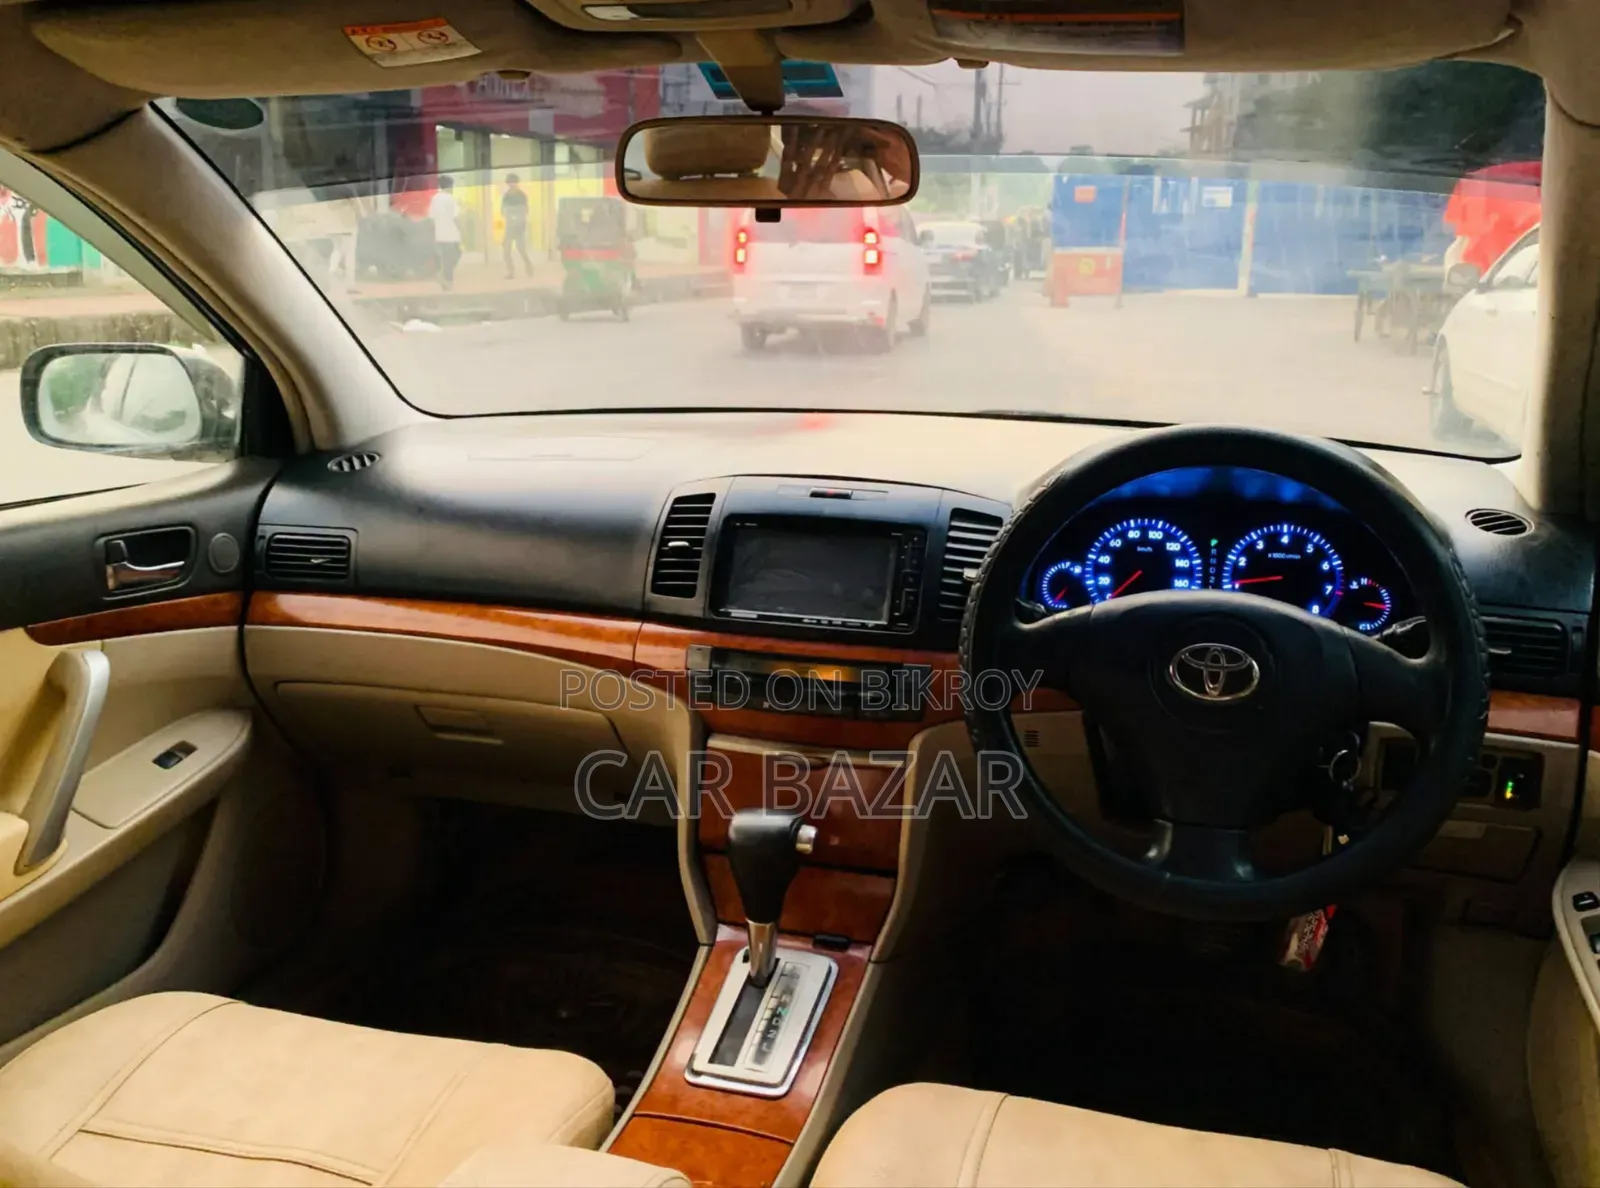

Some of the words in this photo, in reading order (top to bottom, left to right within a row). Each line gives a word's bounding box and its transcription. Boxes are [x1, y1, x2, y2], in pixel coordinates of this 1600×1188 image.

[1127, 530, 1141, 539] 80
[1148, 530, 1164, 540] 100
[1109, 539, 1122, 548] 60
[1280, 535, 1289, 544] 4
[1165, 542, 1181, 551] 120
[1256, 540, 1264, 550] 3
[1306, 544, 1314, 553] 5
[1098, 556, 1111, 565] 40
[1175, 559, 1190, 568] 140
[1238, 556, 1247, 567] 2
[1321, 561, 1330, 570] 6
[1098, 576, 1111, 585] 20
[1360, 577, 1368, 585] H
[1325, 585, 1333, 595] 7
[1312, 604, 1320, 614] 8
